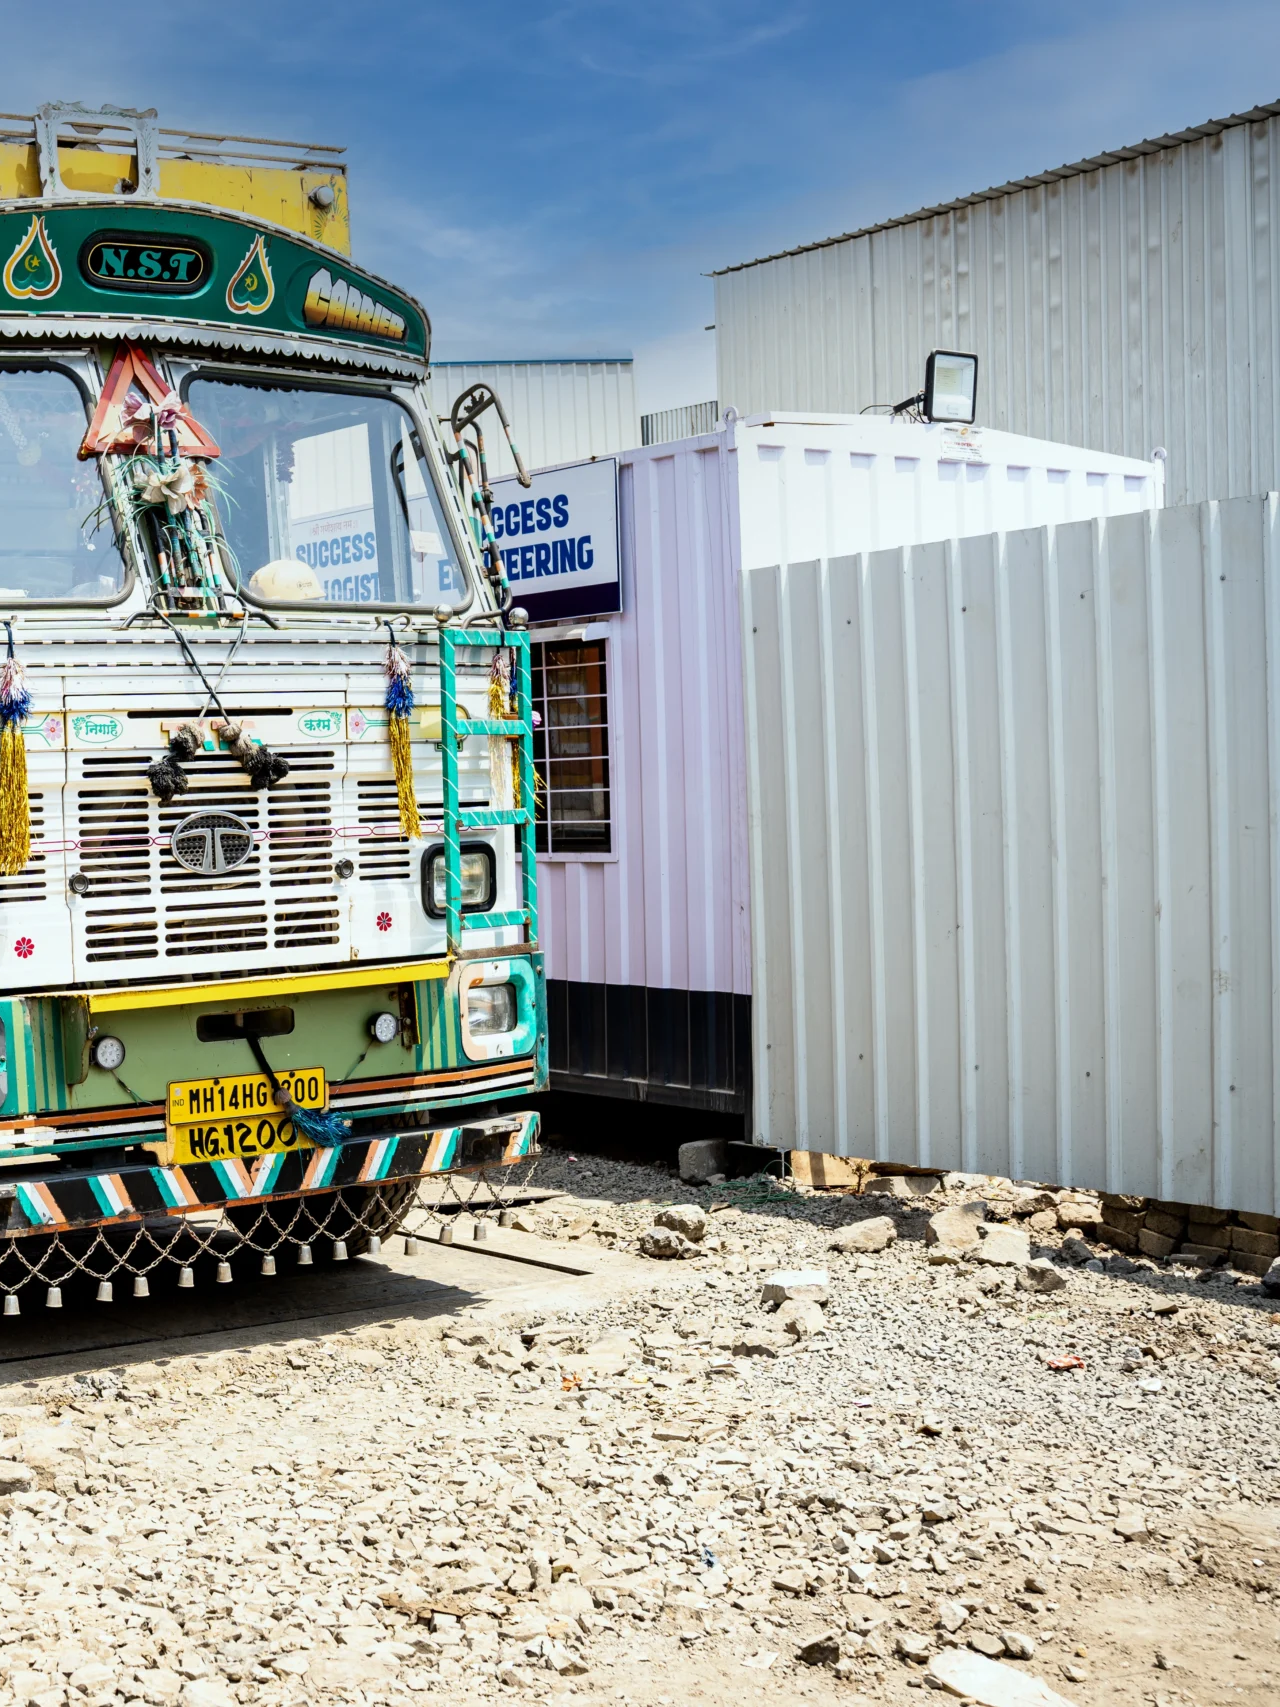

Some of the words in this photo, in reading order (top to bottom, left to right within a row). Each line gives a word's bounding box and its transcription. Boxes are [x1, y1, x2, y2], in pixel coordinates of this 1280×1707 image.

[98, 247, 196, 281] N.S.T
[303, 266, 407, 341] CARRIER
[482, 494, 569, 541] CCESS
[295, 531, 376, 570] SUCCESS
[303, 718, 331, 732] करम
[172, 1098, 185, 1107] IND
[189, 1076, 319, 1115] MH14HG00
